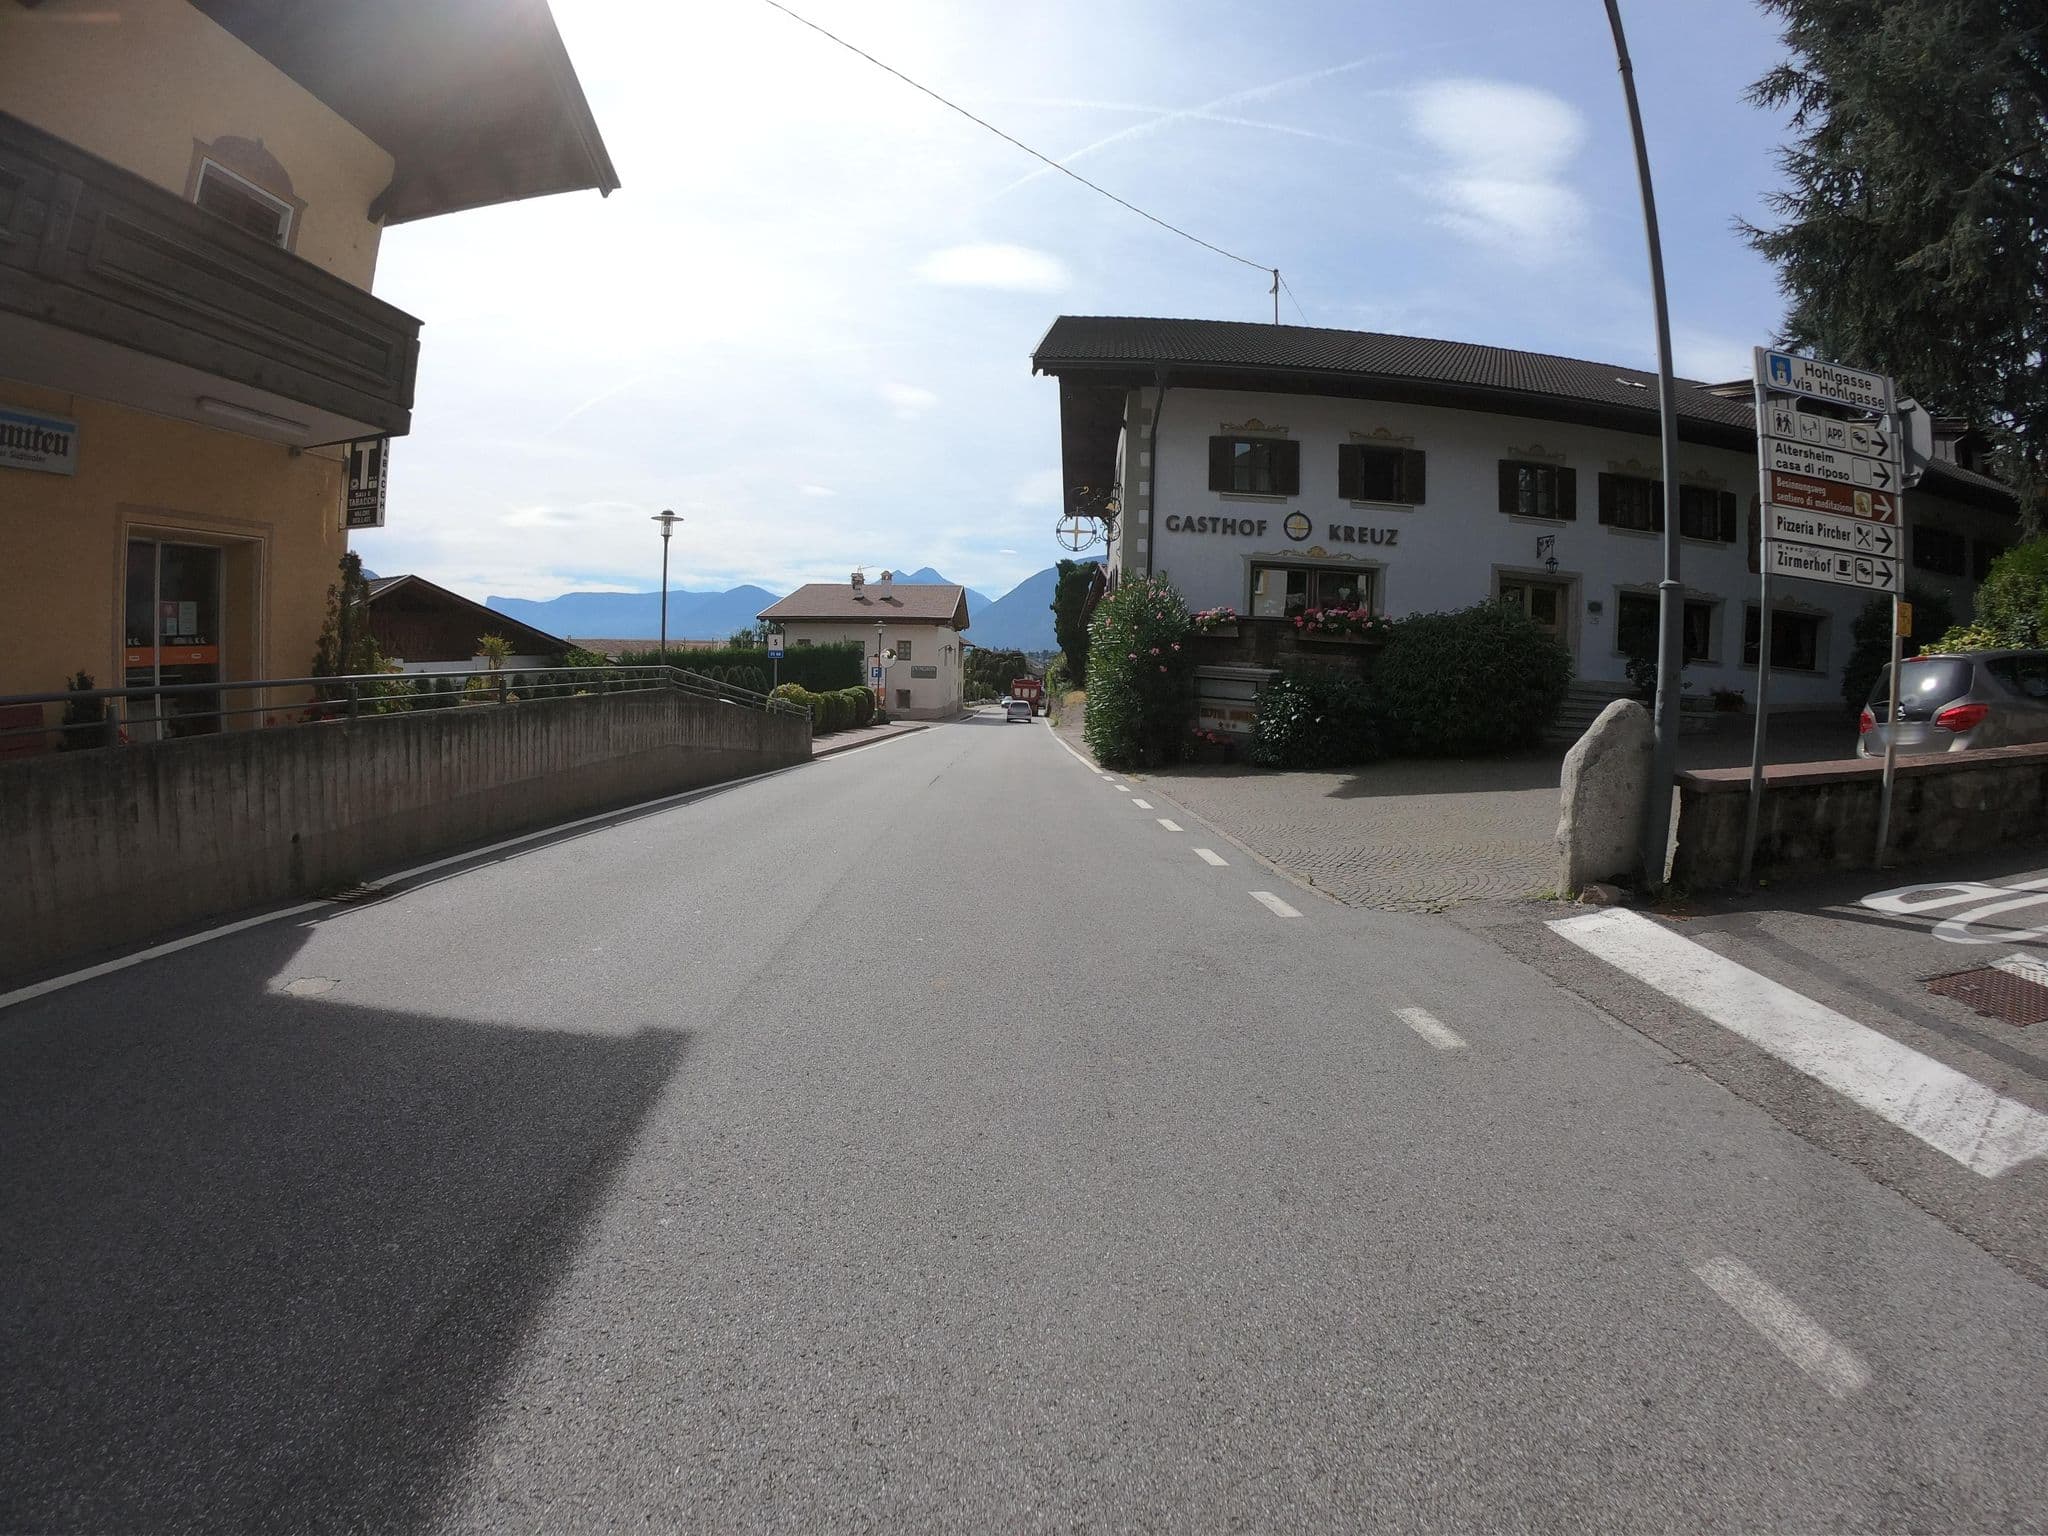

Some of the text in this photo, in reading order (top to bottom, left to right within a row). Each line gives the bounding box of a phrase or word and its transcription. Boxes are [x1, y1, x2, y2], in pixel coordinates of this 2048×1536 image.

[1804, 362, 1871, 390] Hohlgasse
[1792, 377, 1885, 409] via Hohlgasse
[1775, 443, 1835, 464] Altersheim
[1775, 460, 1850, 481] casa di riposo
[1806, 496, 1813, 506] di
[1166, 514, 1399, 547] GASTHOF KREUZ
[1776, 515, 1851, 542] Pizzeria Pircher
[1777, 550, 1832, 573] Zirmerhof
